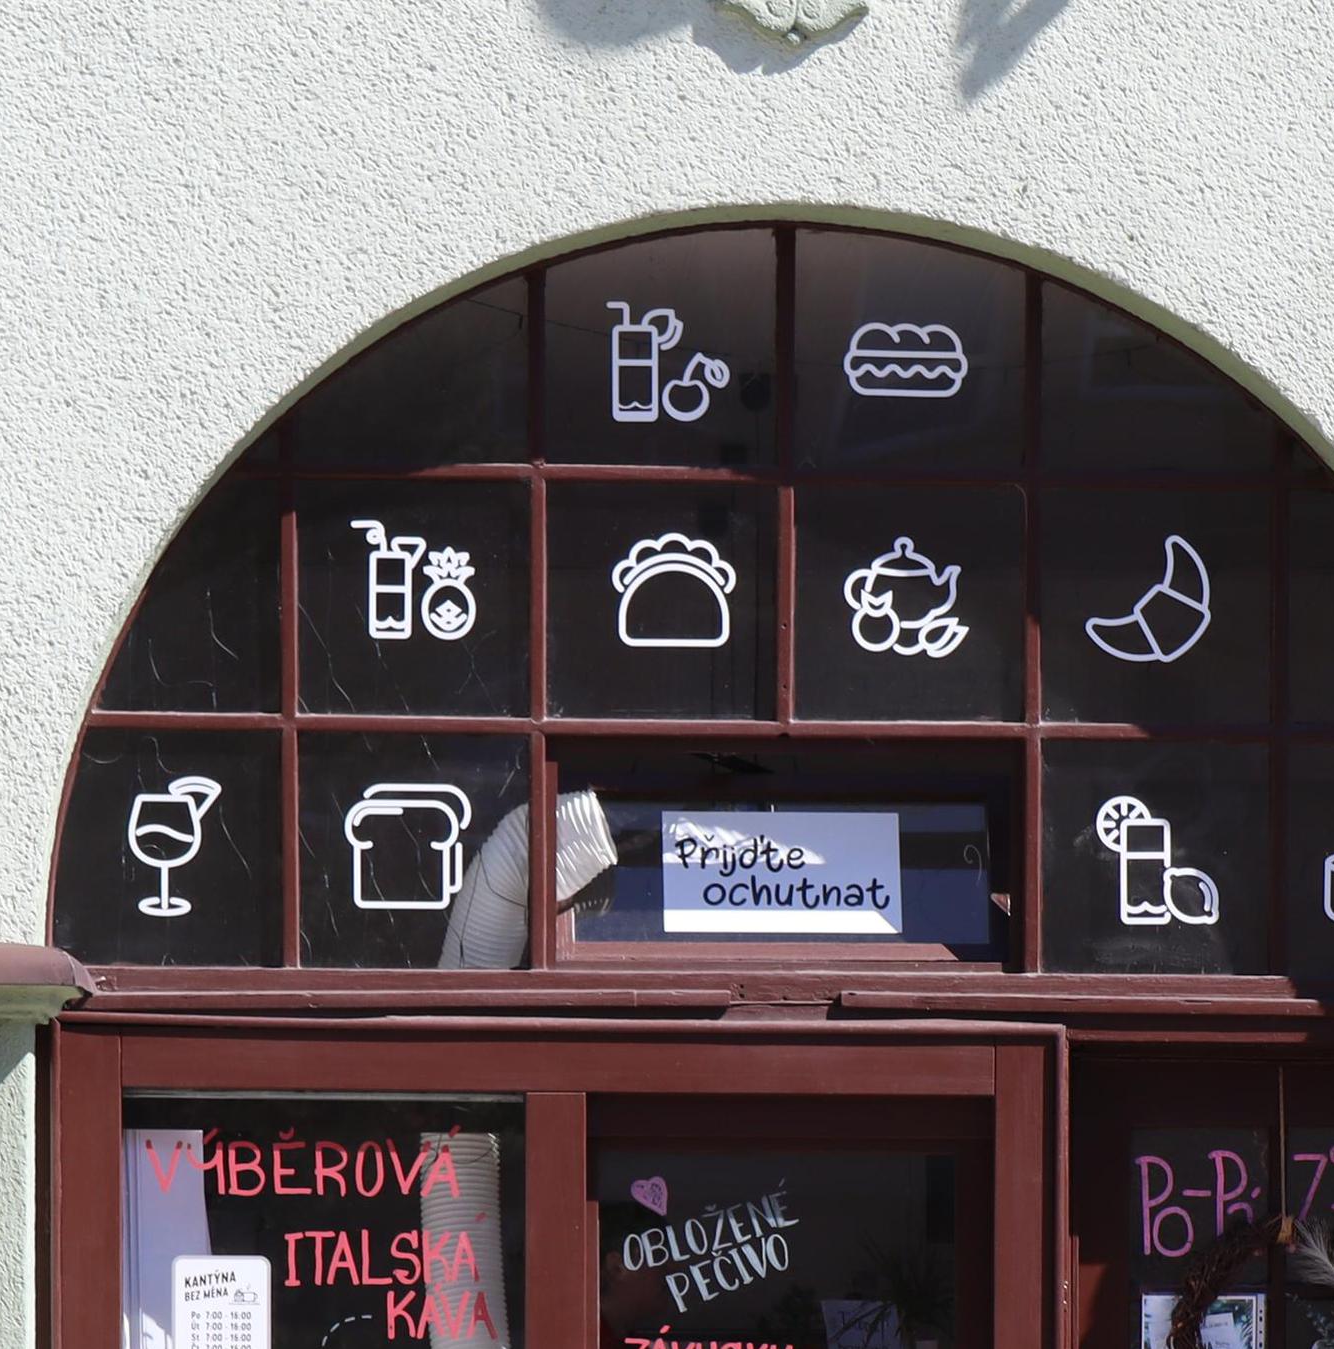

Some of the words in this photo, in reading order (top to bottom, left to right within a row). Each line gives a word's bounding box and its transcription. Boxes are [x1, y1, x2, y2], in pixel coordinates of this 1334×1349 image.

[675, 833, 806, 877] Přijďte
[702, 876, 891, 909] ochutnat
[145, 1125, 461, 1198] VÝBĚROVÁ
[284, 1212, 487, 1287] ITALSKÁ
[623, 1178, 800, 1271] OBLOŽENÉ
[184, 1269, 236, 1288] KANTÝNA
[184, 1291, 200, 1301] BEZ
[203, 1287, 228, 1299] MÉNA
[665, 1233, 789, 1313] PEČIVO
